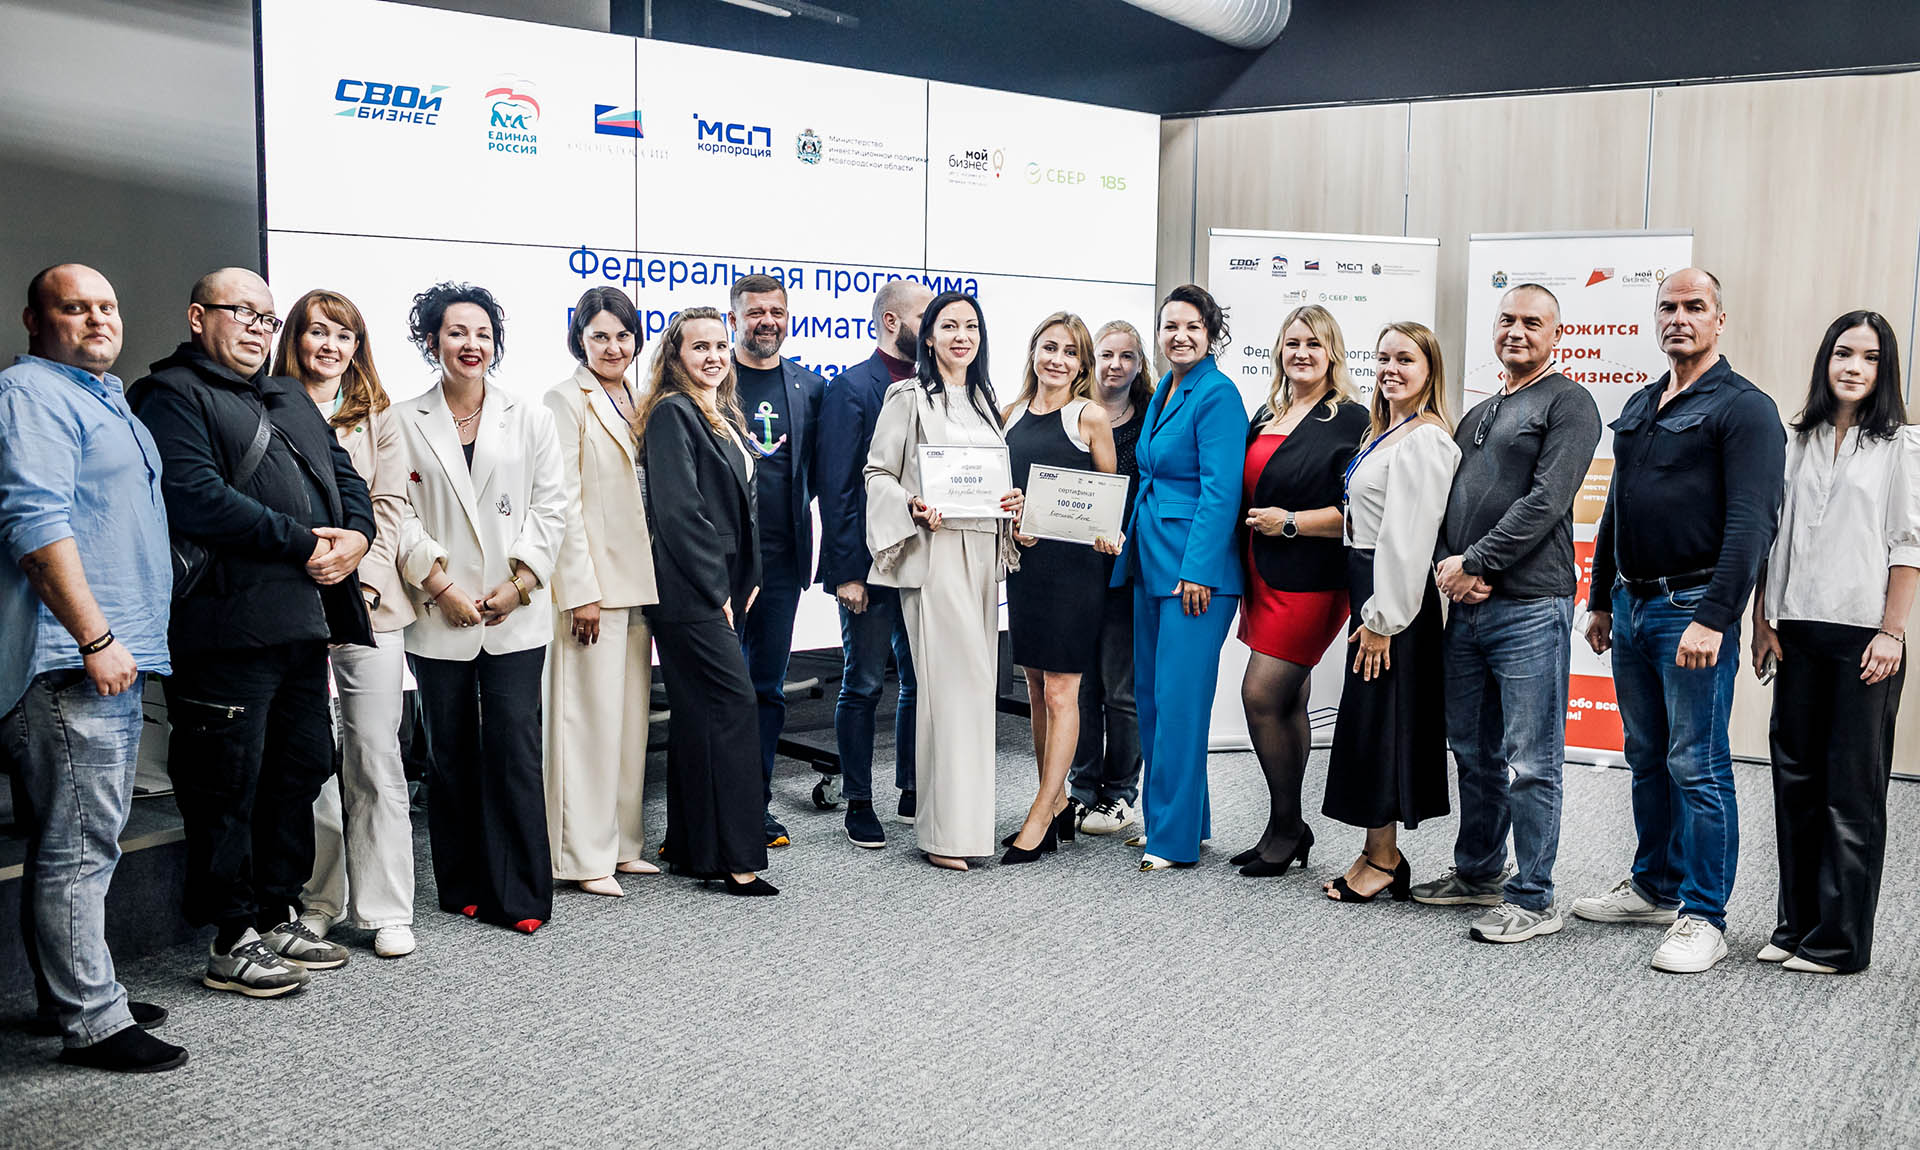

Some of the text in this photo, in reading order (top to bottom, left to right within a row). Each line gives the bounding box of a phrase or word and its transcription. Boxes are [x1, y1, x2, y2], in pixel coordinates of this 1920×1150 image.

[357, 106, 438, 125] БИЗНЕС
[488, 131, 537, 143] ЕДИНАЯ
[828, 135, 883, 147] Министерство
[488, 142, 537, 155] РОССИЯ
[698, 142, 772, 158] корпорация
[828, 147, 929, 163] инвестиционной политики
[965, 149, 988, 161] мой
[828, 157, 914, 172] Новгородской области
[949, 154, 988, 171] бизнес
[1046, 168, 1086, 185] СБЕР
[1100, 175, 1126, 191] 185
[1634, 269, 1652, 277] мой
[815, 268, 979, 299] прогмма
[1564, 324, 1639, 336] ожится
[1552, 348, 1601, 363] тром
[1242, 365, 1258, 375] по
[1058, 488, 1095, 497] сертификат
[1057, 499, 1070, 508] 100
[1072, 501, 1086, 509] 000
[1569, 697, 1593, 708] обо
